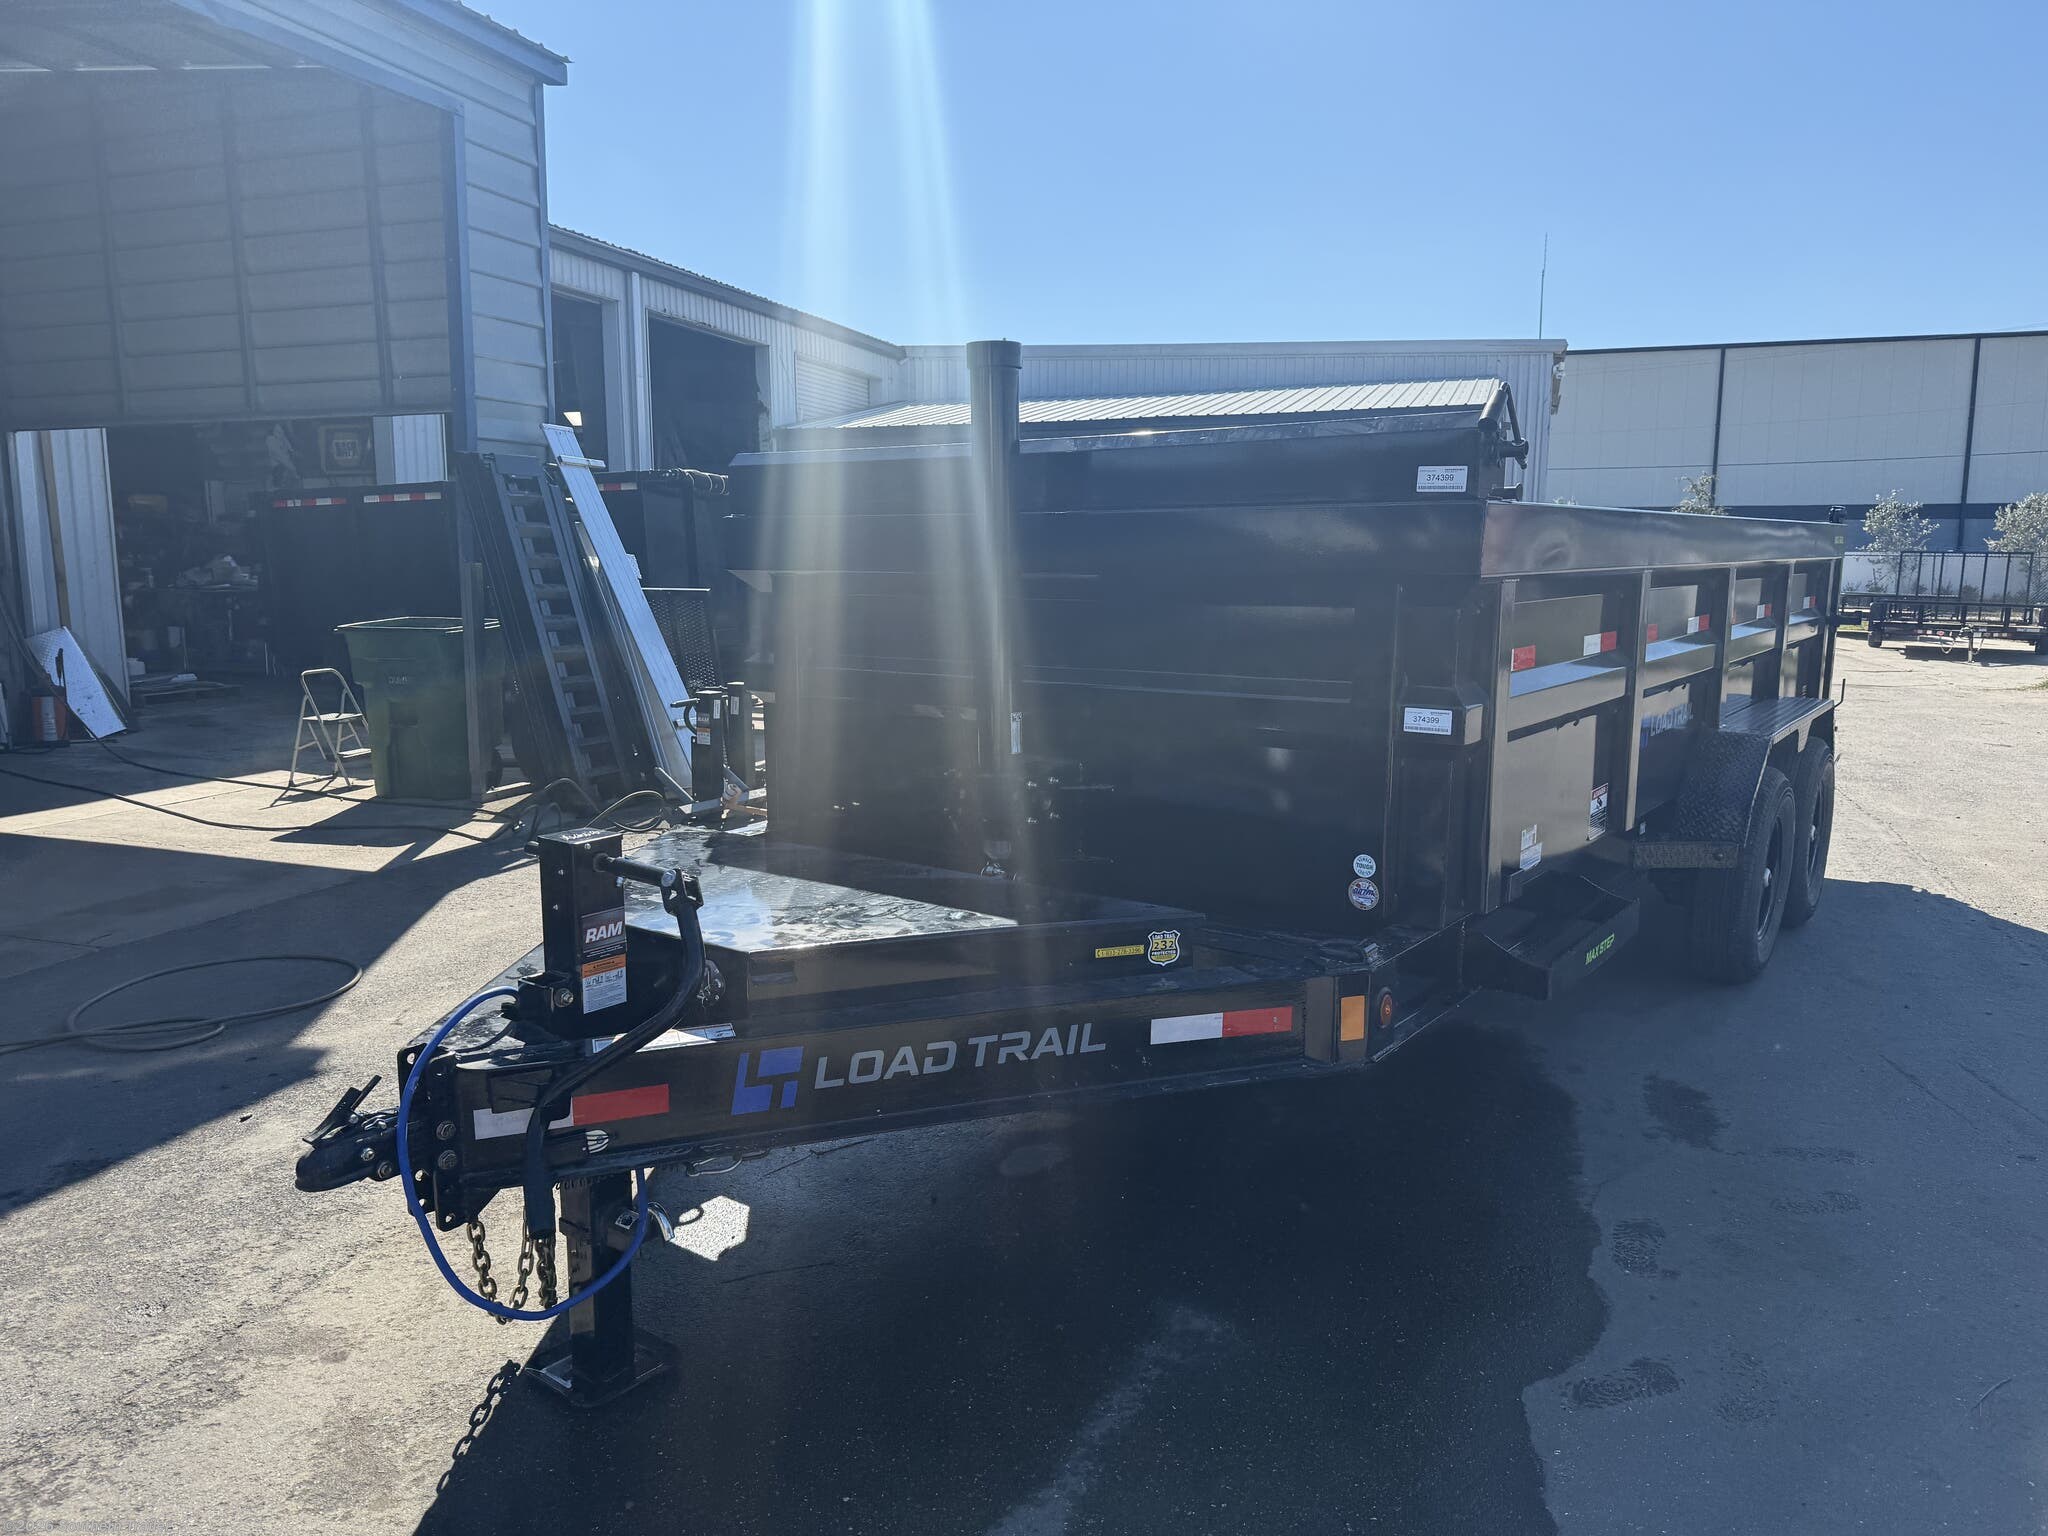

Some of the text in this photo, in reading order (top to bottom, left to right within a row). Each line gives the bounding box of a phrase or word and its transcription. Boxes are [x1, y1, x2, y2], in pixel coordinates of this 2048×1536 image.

[1413, 715, 1440, 724] 374399
[585, 920, 623, 944] RAM
[1153, 940, 1175, 950] 232
[1585, 932, 1615, 966] MAX STEP
[814, 1040, 958, 1090] LOAD
[967, 1022, 1107, 1068] TRAIL
